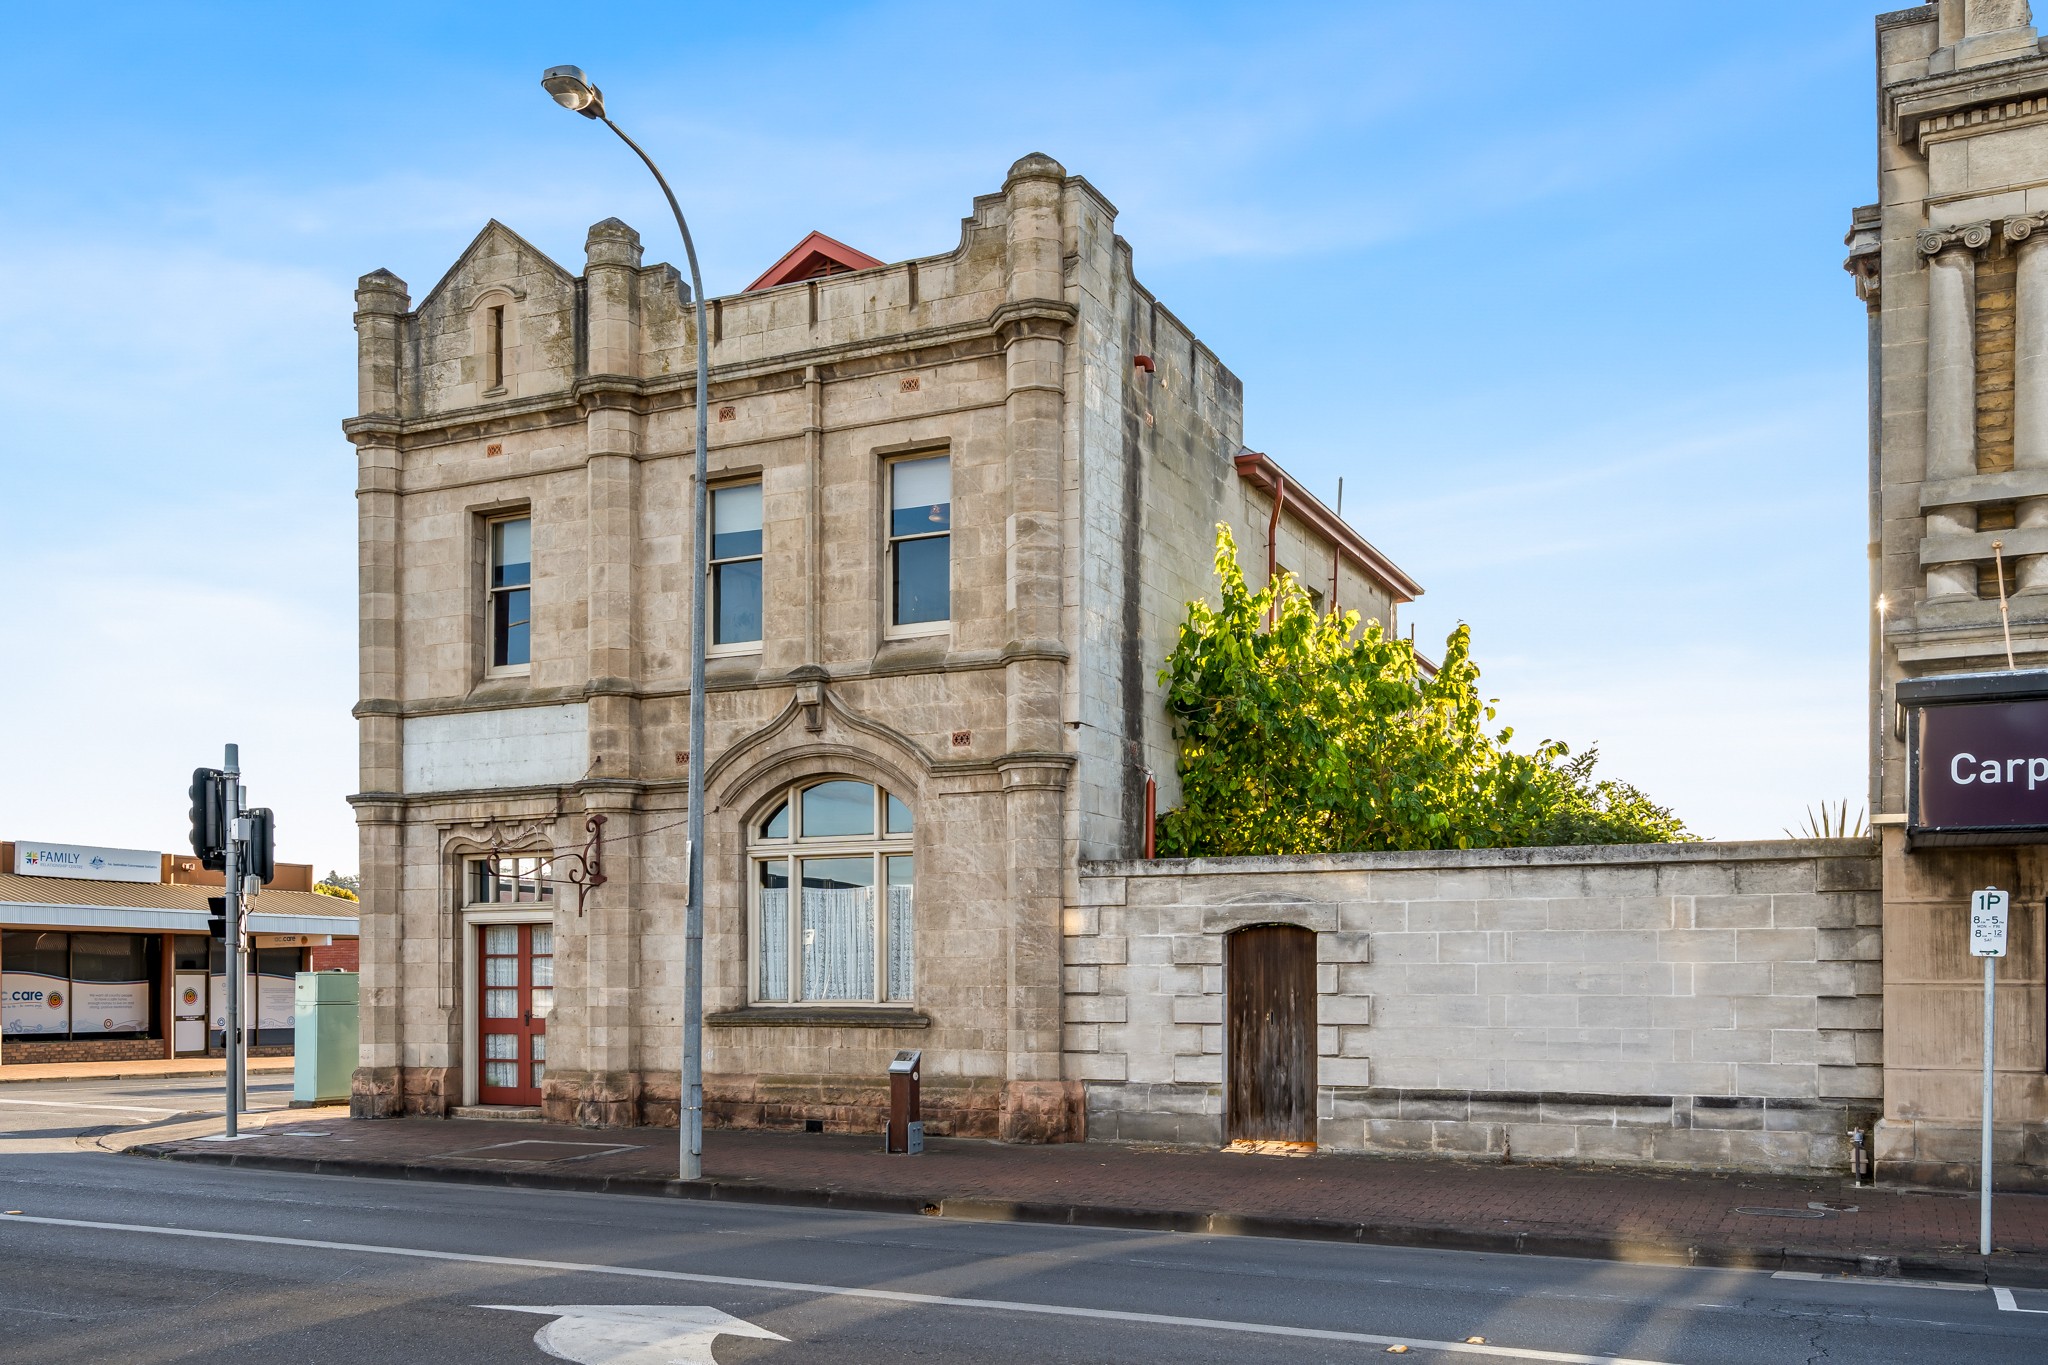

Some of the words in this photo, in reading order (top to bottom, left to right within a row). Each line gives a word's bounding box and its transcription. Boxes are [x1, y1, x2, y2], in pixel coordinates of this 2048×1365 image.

[1951, 752, 2048, 790] Carp
[40, 850, 80, 864] FAMILY
[1979, 895, 2001, 910] 1P
